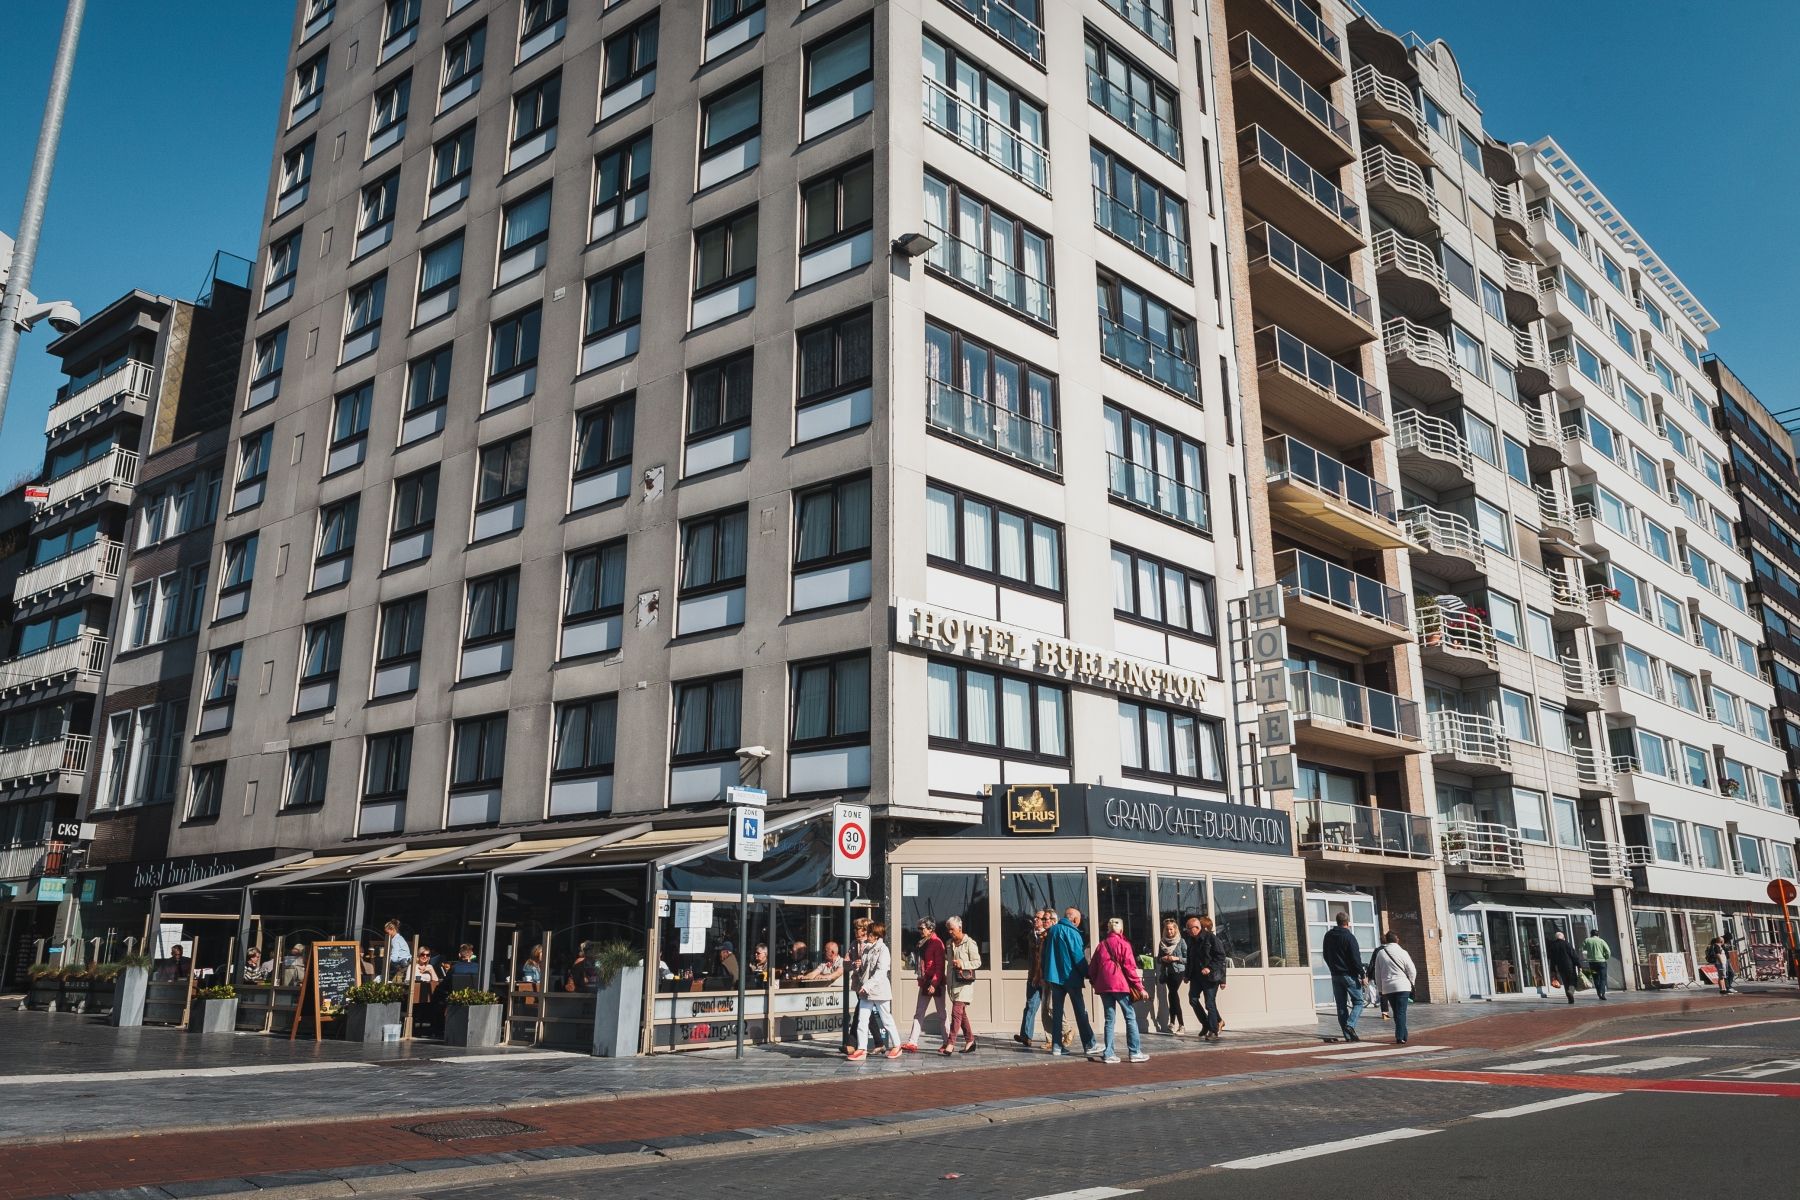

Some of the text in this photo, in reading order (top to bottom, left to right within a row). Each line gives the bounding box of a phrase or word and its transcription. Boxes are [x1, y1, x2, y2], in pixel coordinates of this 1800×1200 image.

[912, 607, 1208, 702] HOTEL BURLINGTON
[1253, 589, 1288, 786] HOTEL
[743, 808, 758, 817] ZONE
[843, 809, 862, 819] ZONE
[1011, 811, 1056, 822] PETRUS
[1106, 798, 1285, 844] GRAND CAFE BURLINGTON
[58, 823, 79, 836] CKS
[845, 831, 859, 843] 30
[134, 863, 165, 888] hotel
[692, 996, 716, 1017] grand
